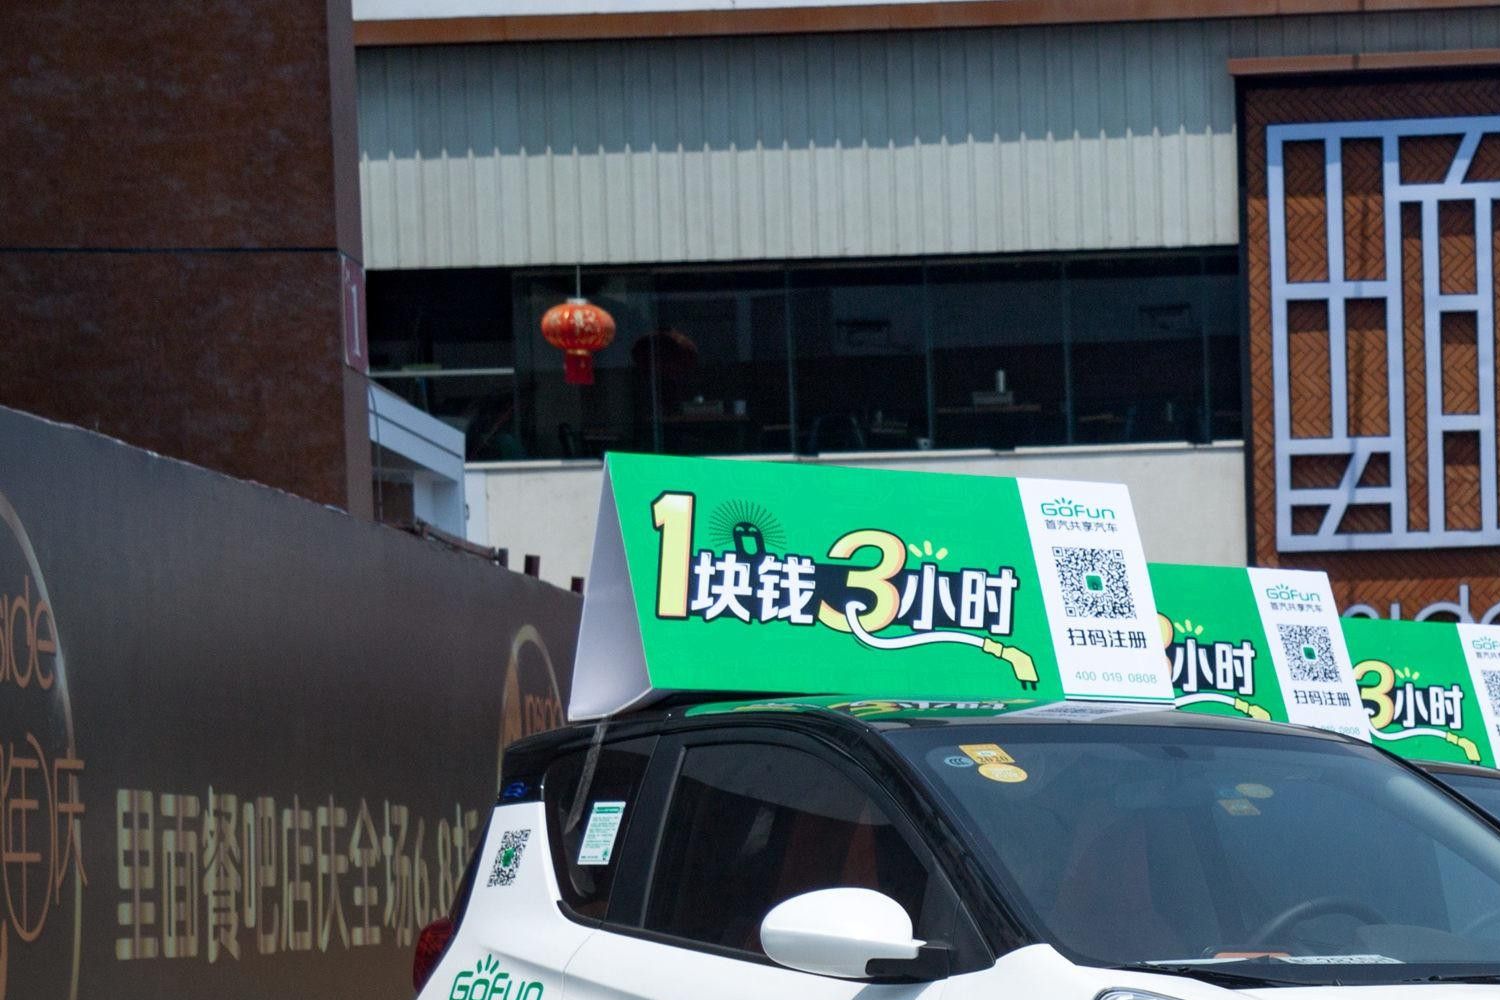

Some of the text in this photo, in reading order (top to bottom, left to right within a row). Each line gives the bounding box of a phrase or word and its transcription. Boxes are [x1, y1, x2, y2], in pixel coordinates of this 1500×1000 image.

[1041, 497, 1116, 520] GoFun
[1045, 519, 1118, 533] 首汽共享汽车
[652, 491, 1018, 635] 1块钱3小时
[1266, 583, 1321, 601] GoFun
[1067, 627, 1148, 649] 扫码注册
[1157, 613, 1256, 696] 小时
[1075, 671, 1158, 685] 400 019 0808
[1293, 689, 1352, 708] 扫码注册
